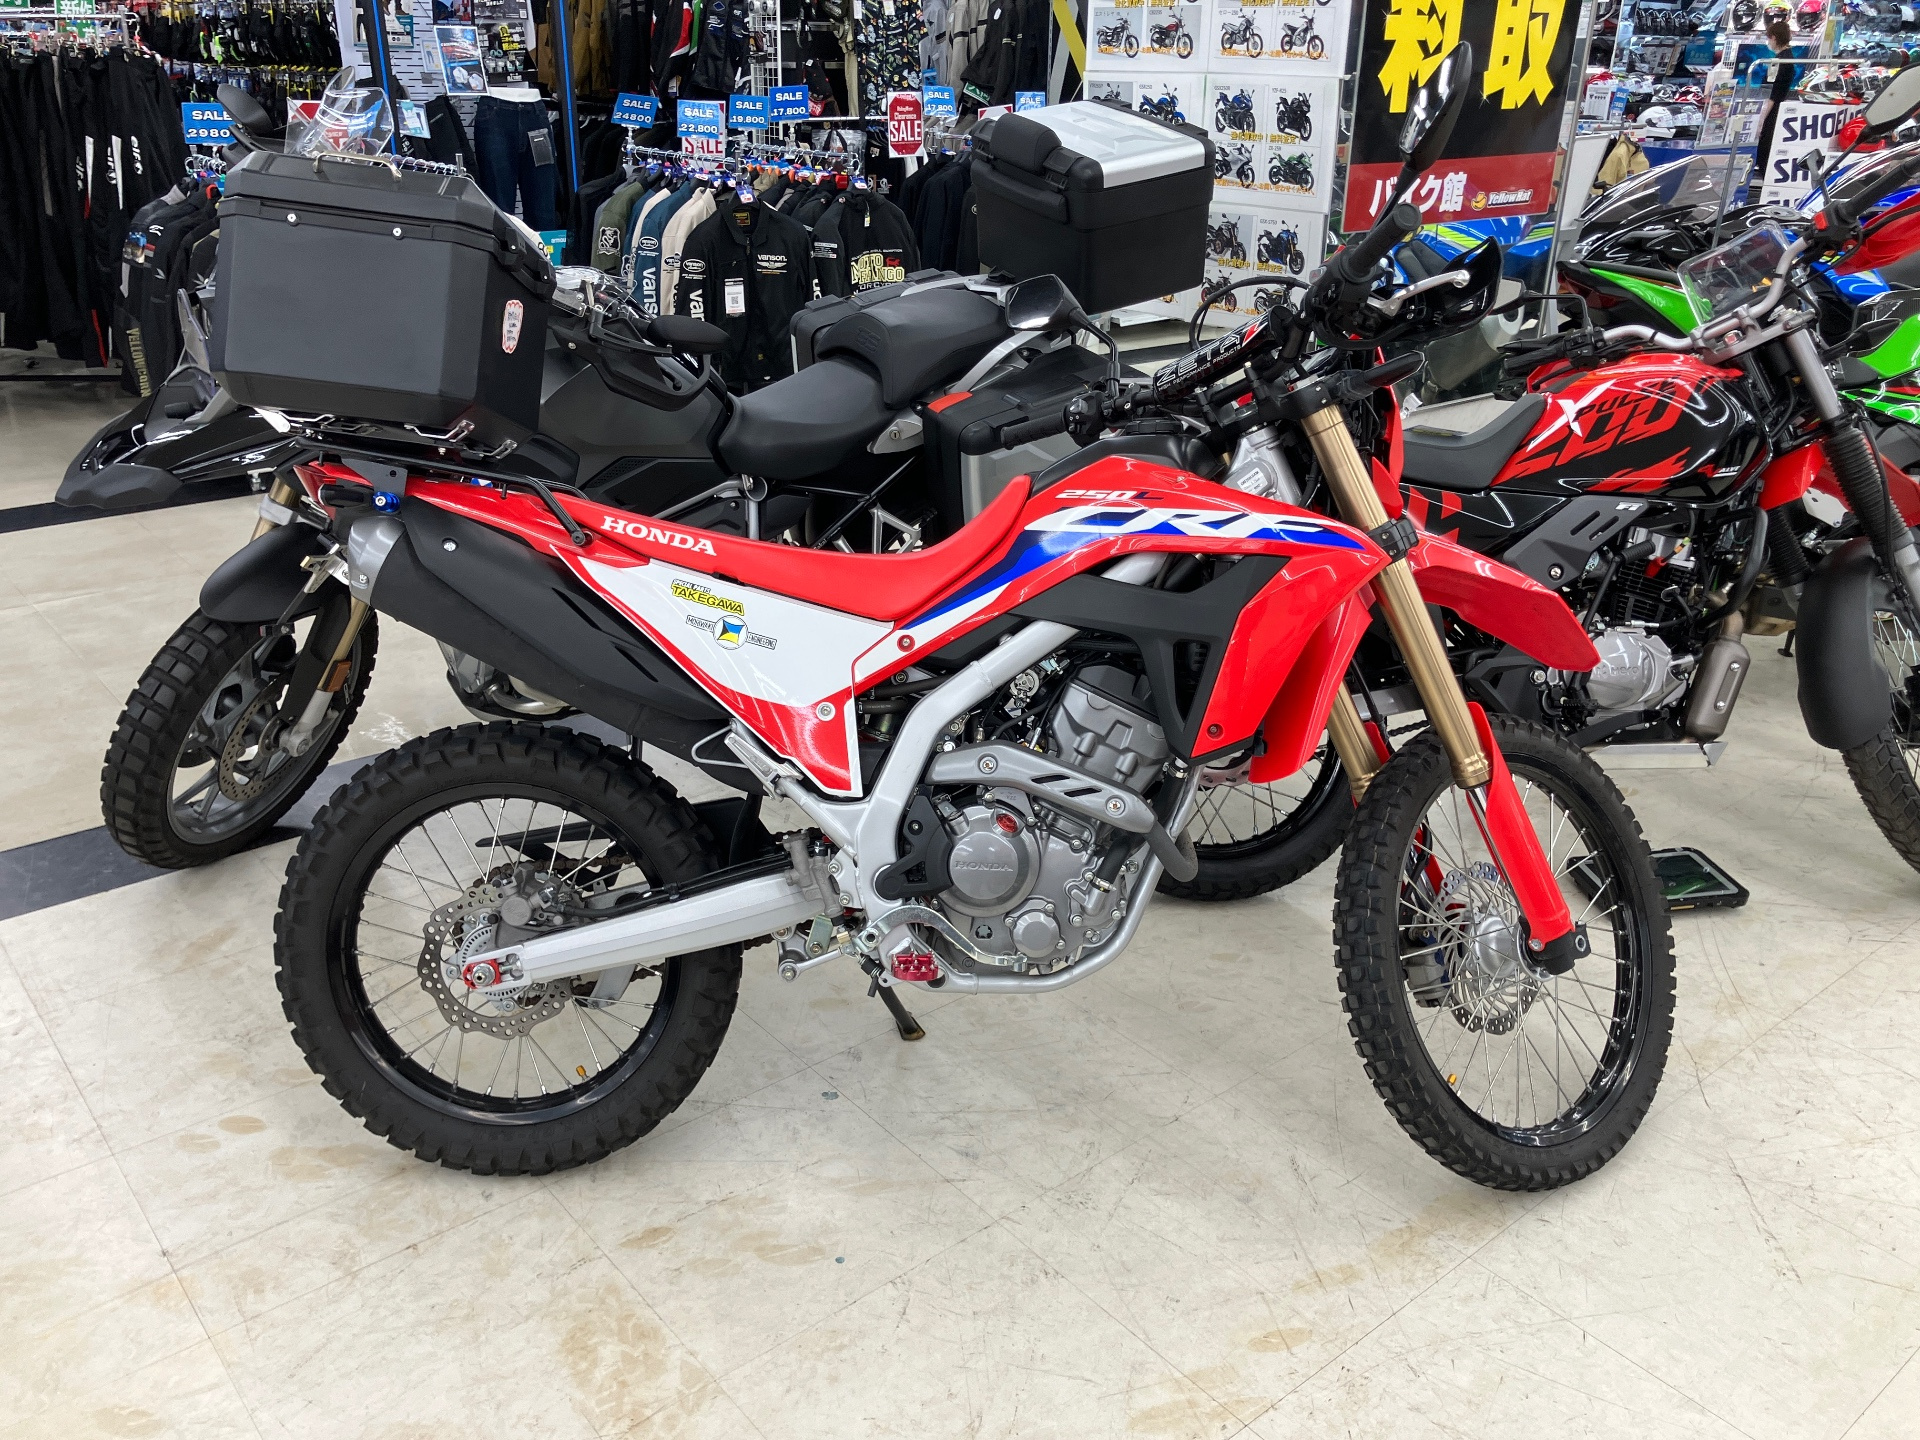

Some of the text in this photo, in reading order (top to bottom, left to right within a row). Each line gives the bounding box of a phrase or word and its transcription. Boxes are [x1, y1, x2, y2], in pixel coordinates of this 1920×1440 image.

[775, 91, 803, 101] SALE
[928, 91, 950, 99] SALE
[622, 99, 652, 110] SALE
[735, 101, 763, 110] SALE
[192, 110, 233, 121] SALE
[684, 107, 714, 118] SALE
[890, 120, 922, 142] SALE
[1055, 489, 1164, 500] 250L
[600, 515, 717, 557] HONDA
[672, 585, 744, 615] TAKEGAWA
[955, 860, 1013, 872] HONDA
